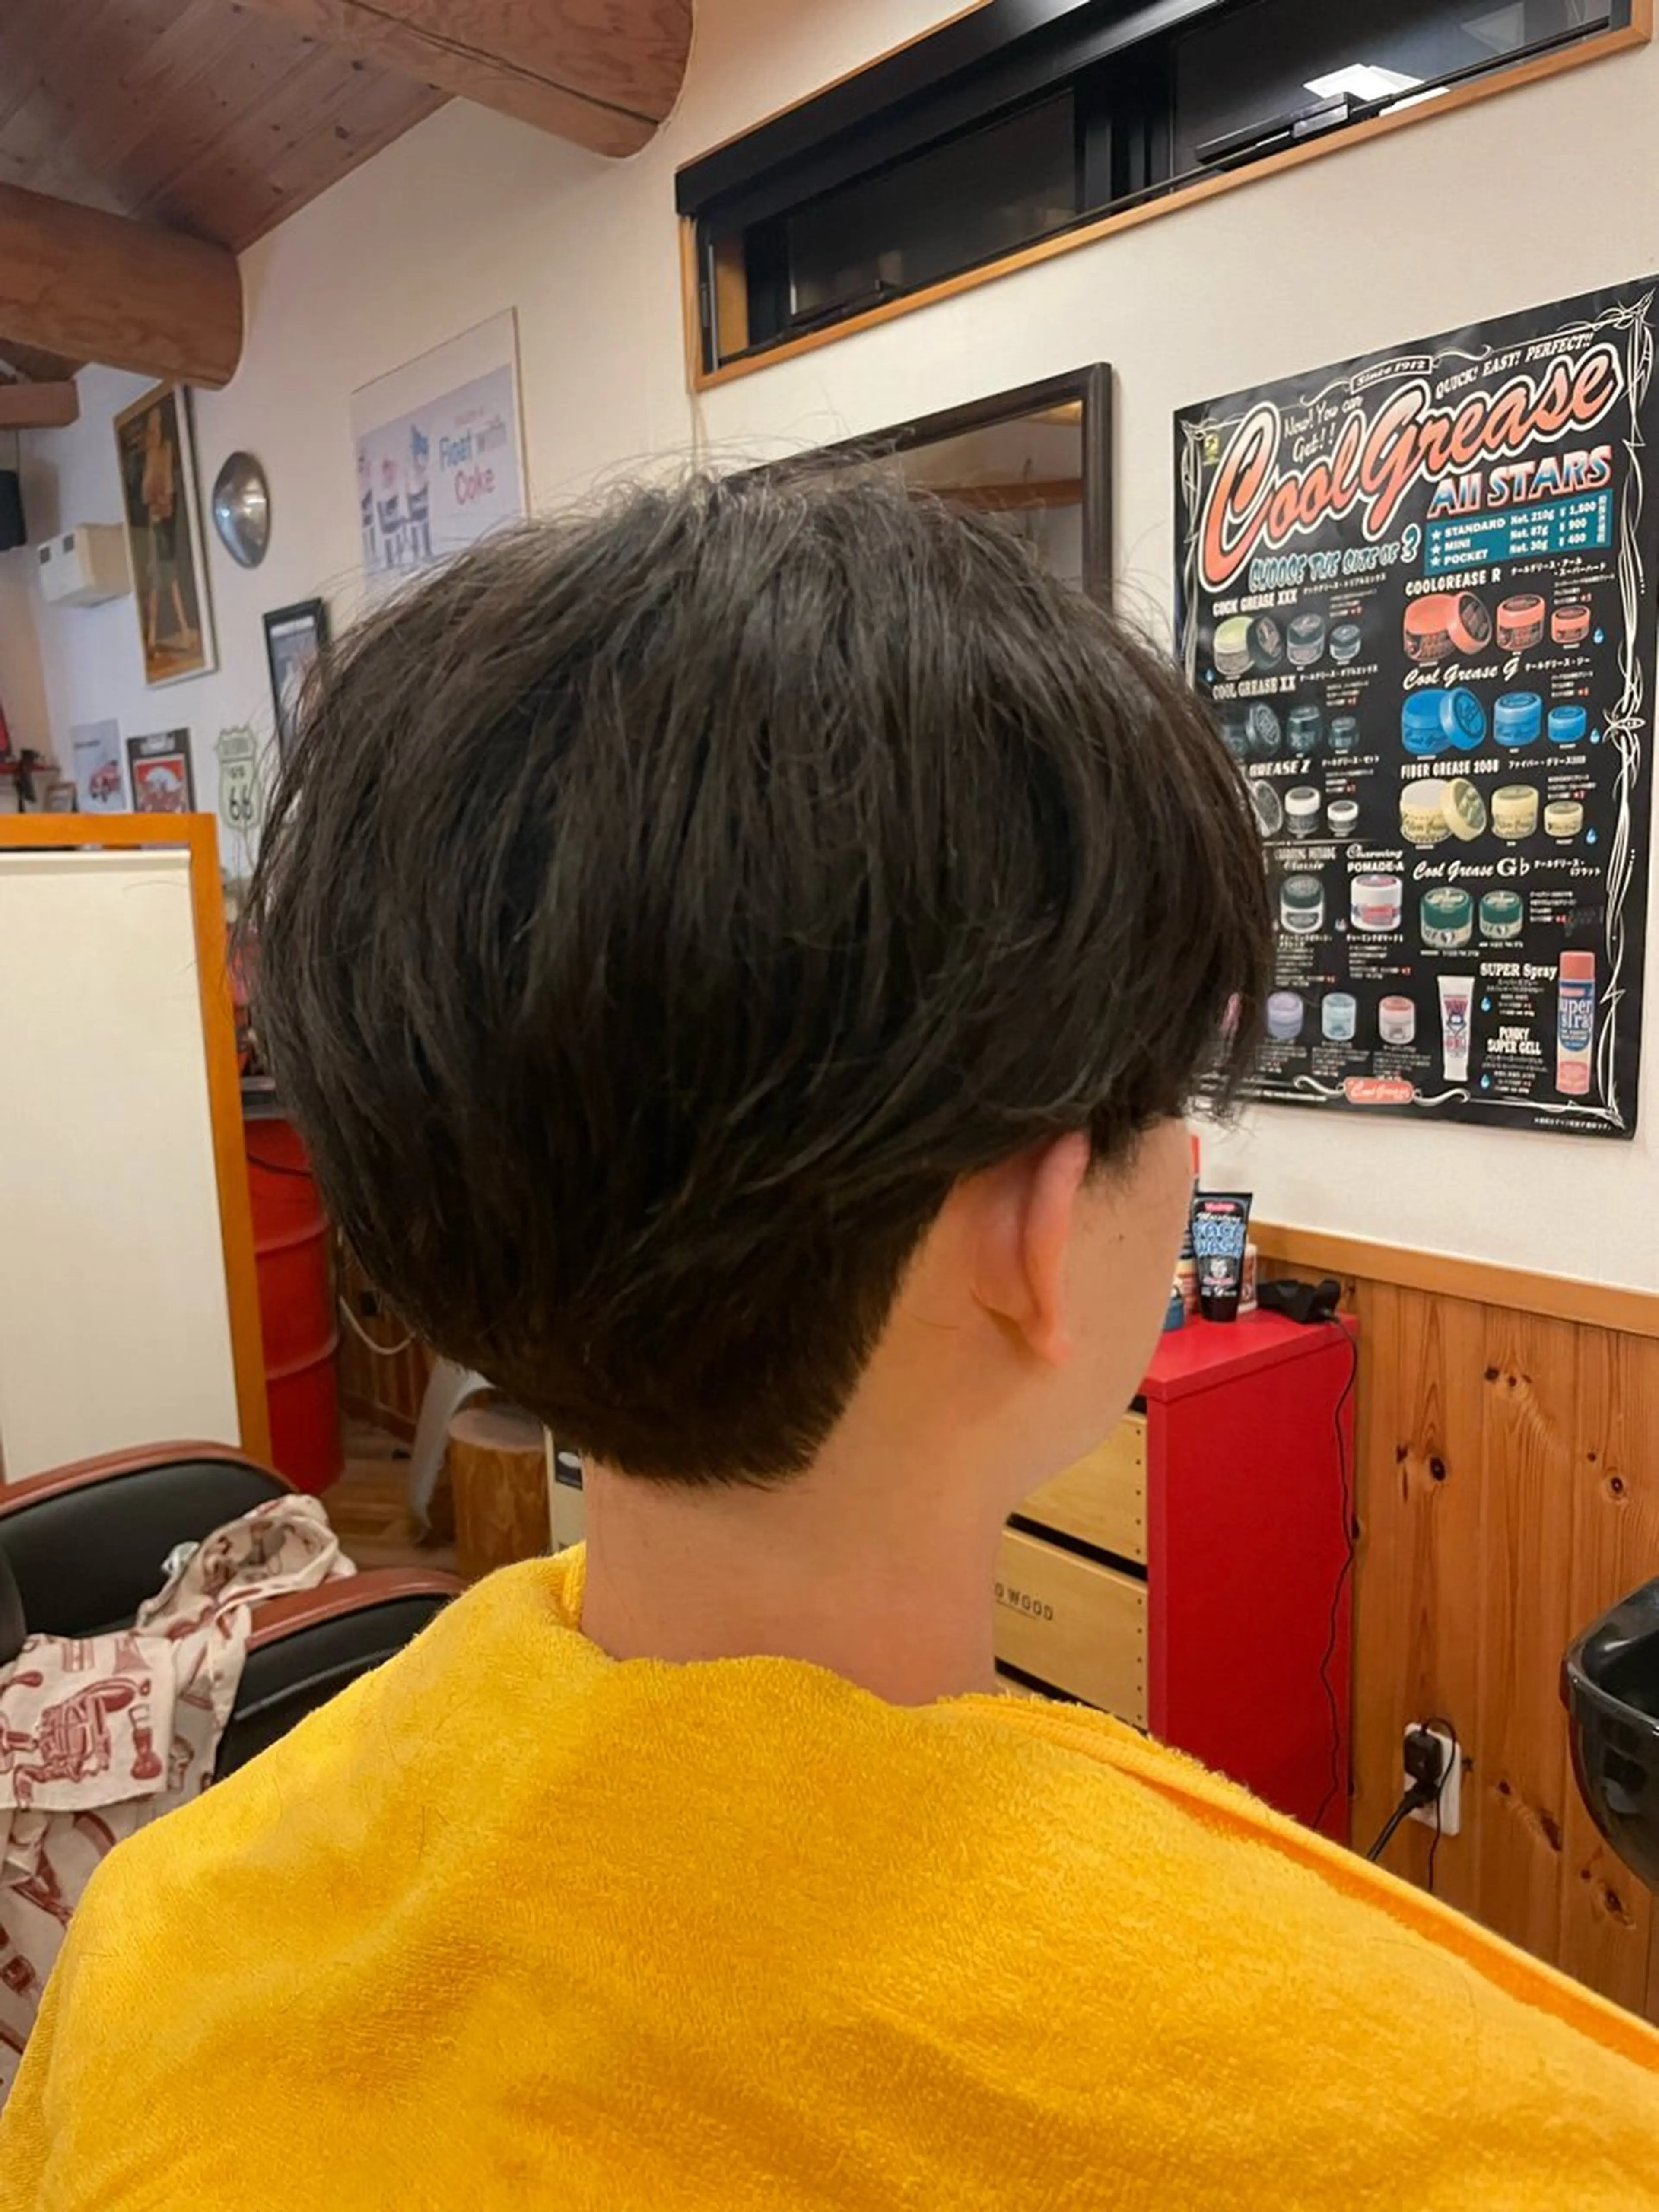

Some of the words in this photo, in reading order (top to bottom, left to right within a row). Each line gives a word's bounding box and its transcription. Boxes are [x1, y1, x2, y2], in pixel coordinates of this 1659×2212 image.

[1435, 369, 1479, 399] QUICK!
[1482, 353, 1522, 377] EASY!
[1525, 333, 1594, 363] PERFECT!!
[1284, 409, 1314, 438] Now!
[1316, 400, 1338, 423] You
[1341, 396, 1364, 413] can
[1487, 445, 1612, 507] STARS
[1444, 518, 1506, 539] STANDARD
[1401, 522, 1422, 563] 3
[1444, 538, 1471, 552] MINI
[1443, 549, 1489, 566] POCKET
[1491, 568, 1502, 584] R
[1277, 588, 1297, 605] XXX
[1402, 668, 1441, 690] Cool
[1442, 663, 1499, 689] Grease
[1238, 677, 1278, 697] GREASE
[1249, 760, 1299, 778] GREASE
[1300, 758, 1312, 774] Z
[1400, 764, 1430, 780] FIBER
[1432, 760, 1471, 777] GREASE
[1346, 843, 1403, 860] Charming
[1412, 860, 1444, 881] Cool
[1446, 859, 1494, 882] Grease
[1479, 962, 1521, 977] SUPER
[1522, 963, 1559, 982] Spray
